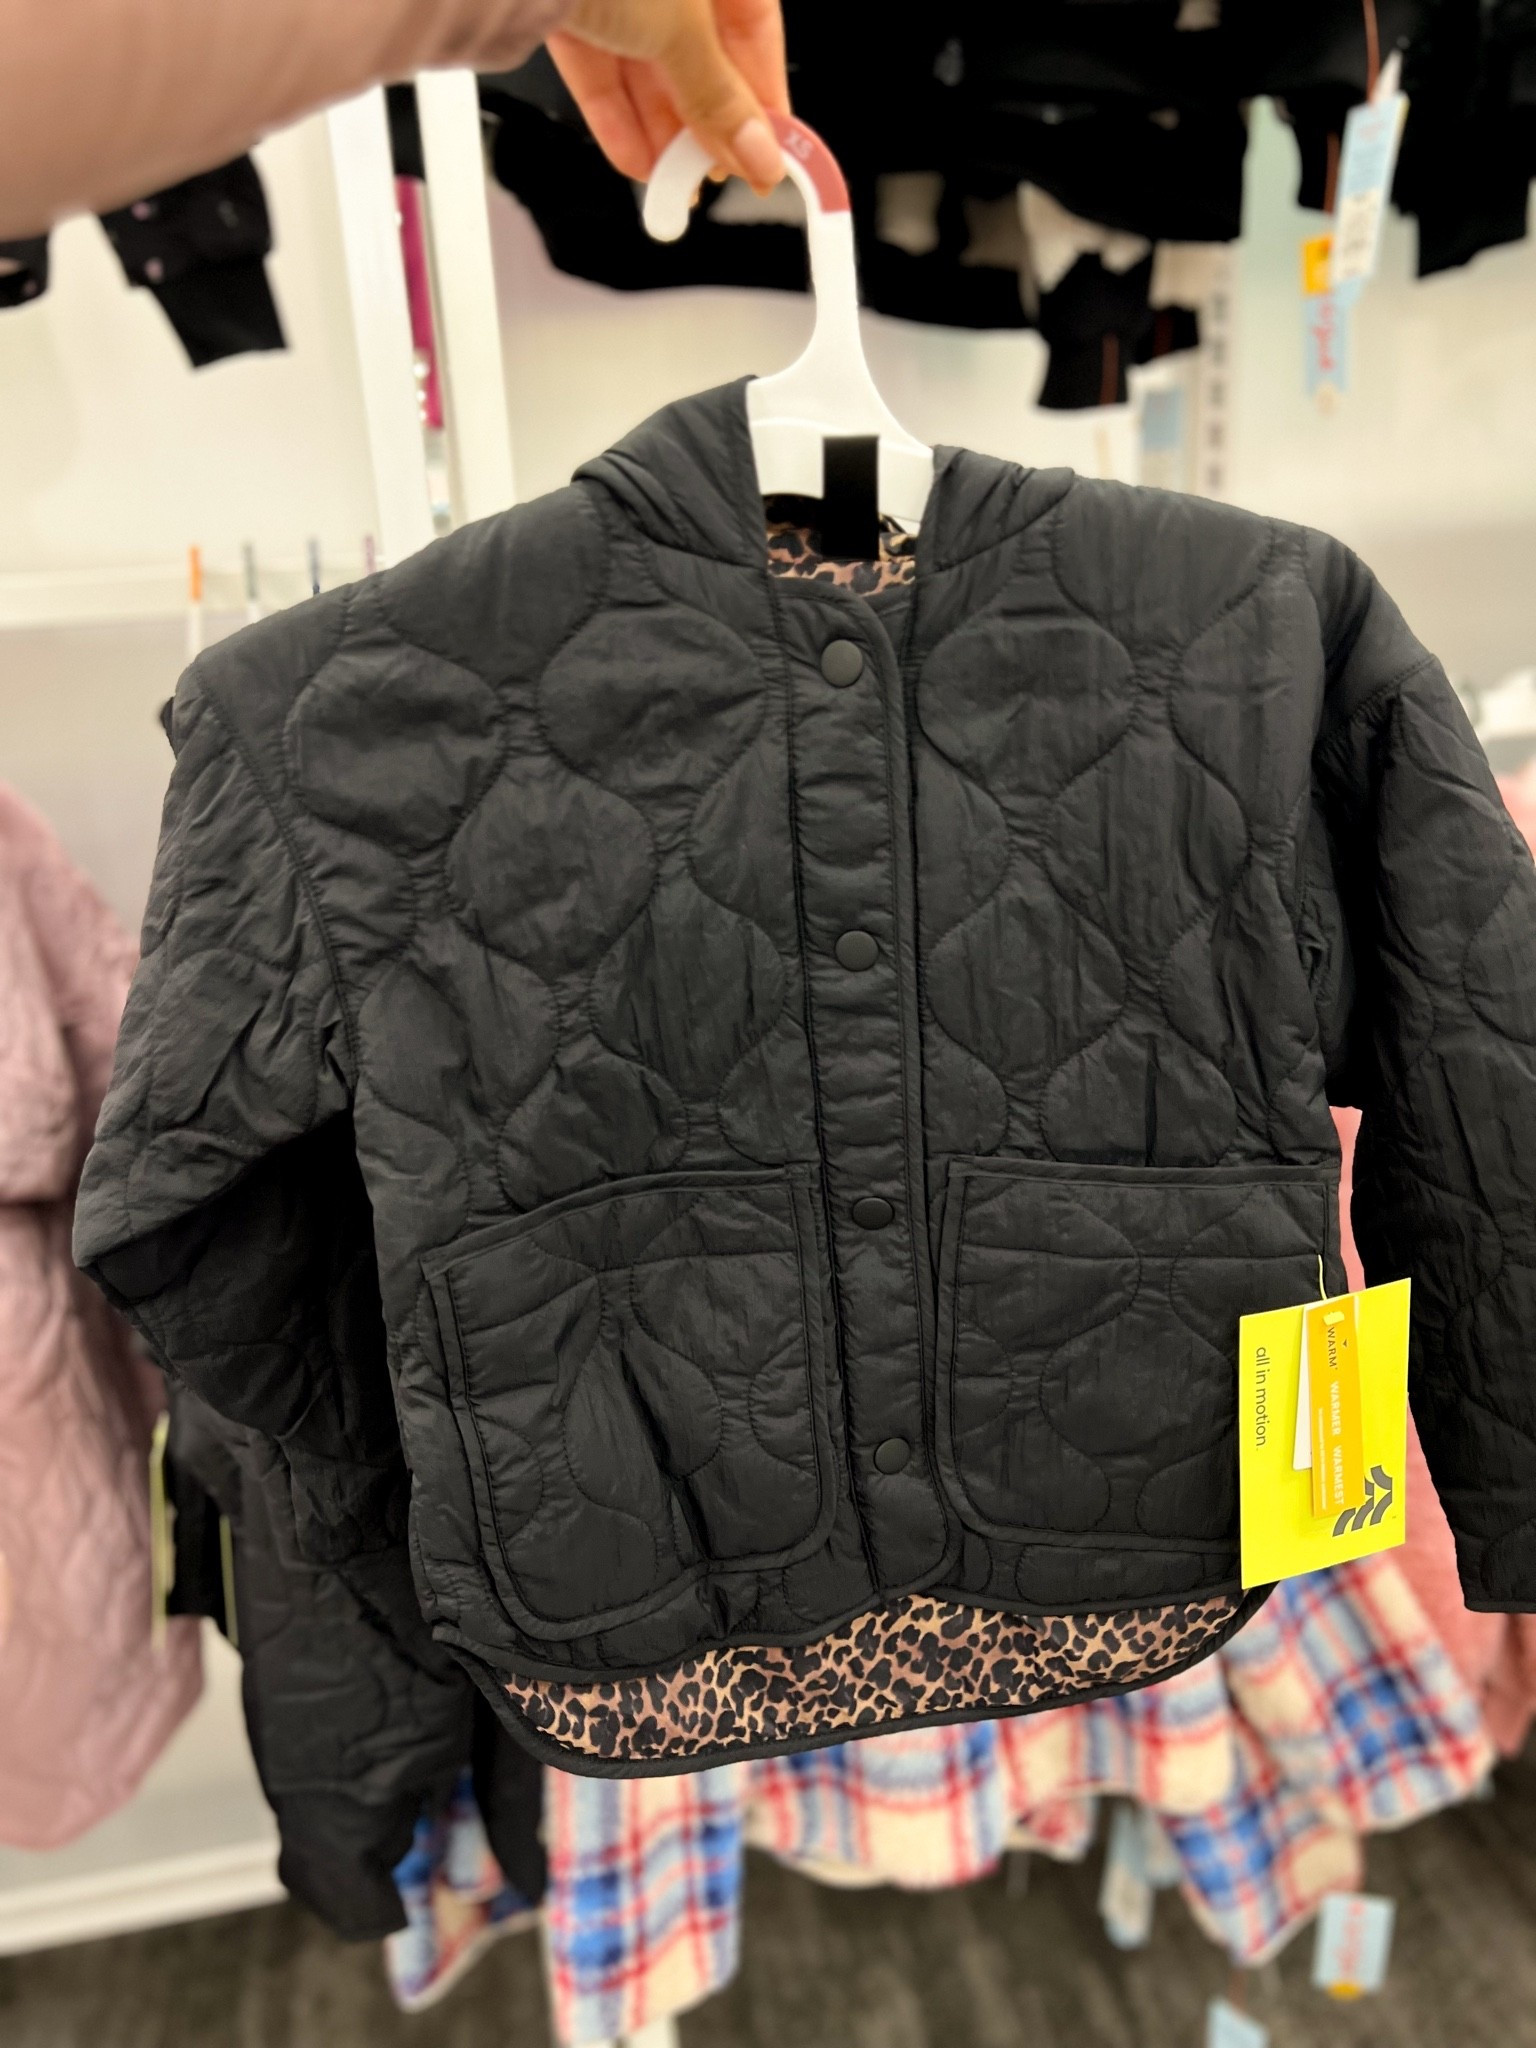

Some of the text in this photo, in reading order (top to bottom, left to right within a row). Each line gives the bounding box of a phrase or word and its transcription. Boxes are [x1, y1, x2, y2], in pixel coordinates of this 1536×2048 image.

[1256, 1347, 1270, 1446] all in motion
[1327, 1326, 1345, 1506] WARM WARMER WARMEST
